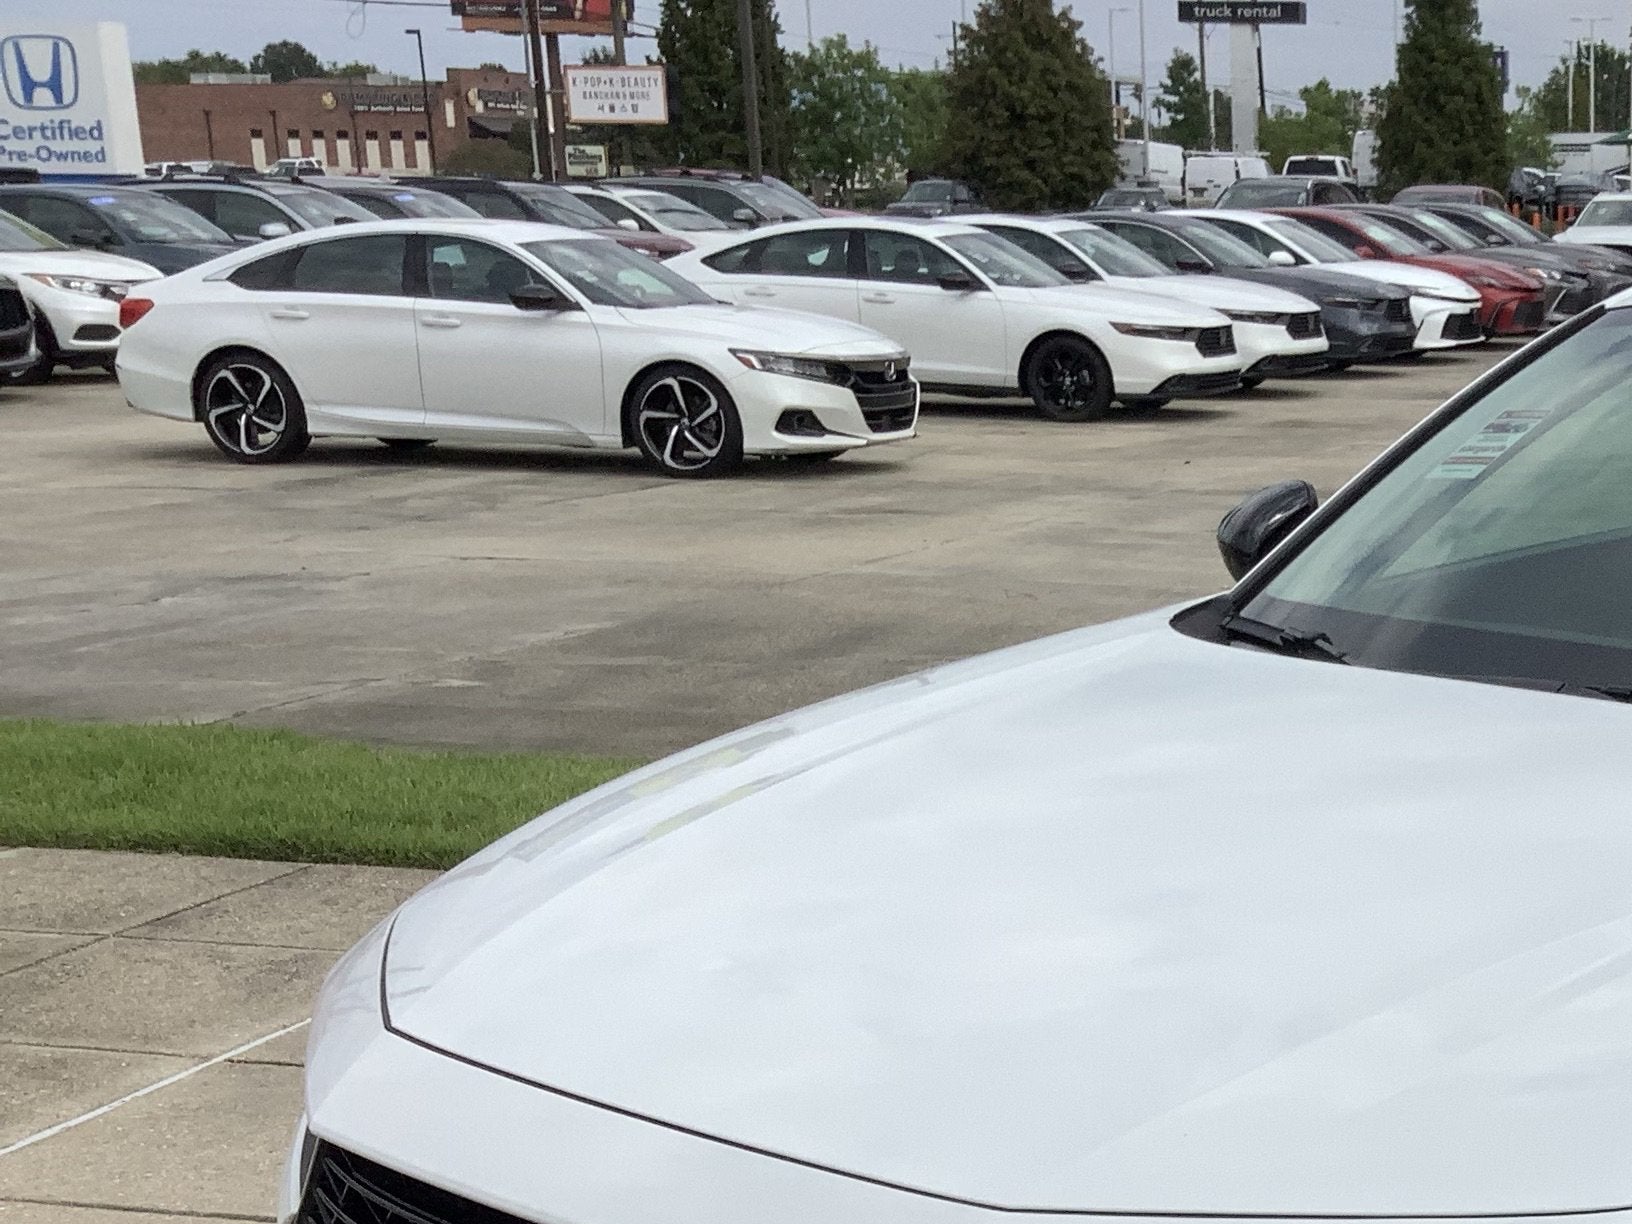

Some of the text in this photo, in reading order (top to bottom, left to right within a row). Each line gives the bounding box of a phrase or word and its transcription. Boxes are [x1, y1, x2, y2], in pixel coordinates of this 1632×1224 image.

[1193, 4, 1282, 18] truck rental
[0, 118, 104, 141] Certified
